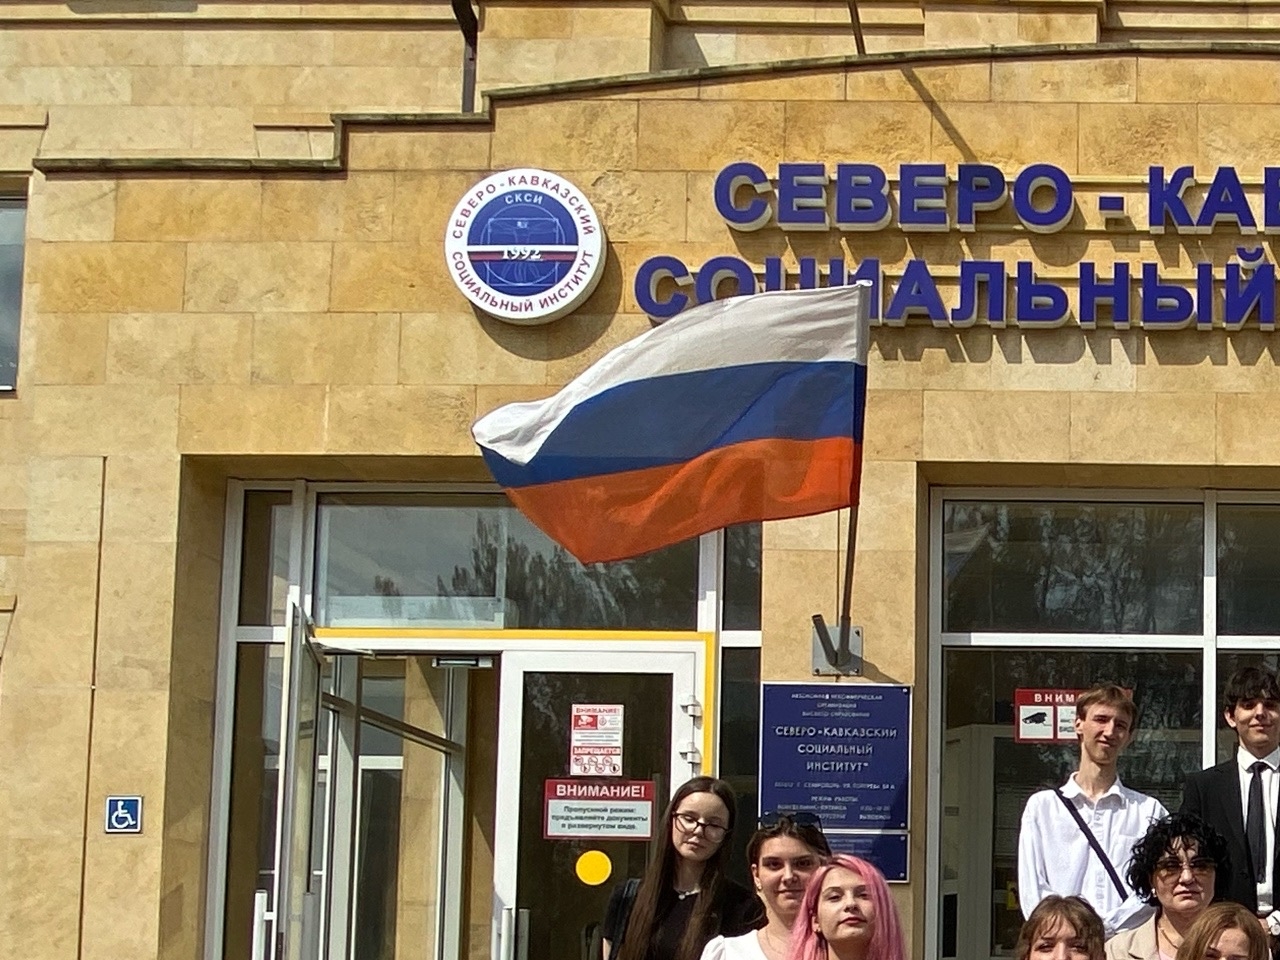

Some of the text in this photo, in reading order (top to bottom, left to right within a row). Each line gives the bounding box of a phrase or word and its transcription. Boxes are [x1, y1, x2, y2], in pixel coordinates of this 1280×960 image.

[505, 193, 544, 205] СКСИ
[714, 162, 1075, 231] СЕВЕРО
[501, 247, 543, 260] 1992
[453, 251, 594, 313] СОЦИАЛЬНЫЙ ИНСТИТУТ
[1034, 693, 1075, 702] ВНИМ
[797, 744, 873, 755] СОЦИАЛЬНЫЙ
[556, 784, 645, 798] ВНИМАНИЕ!
